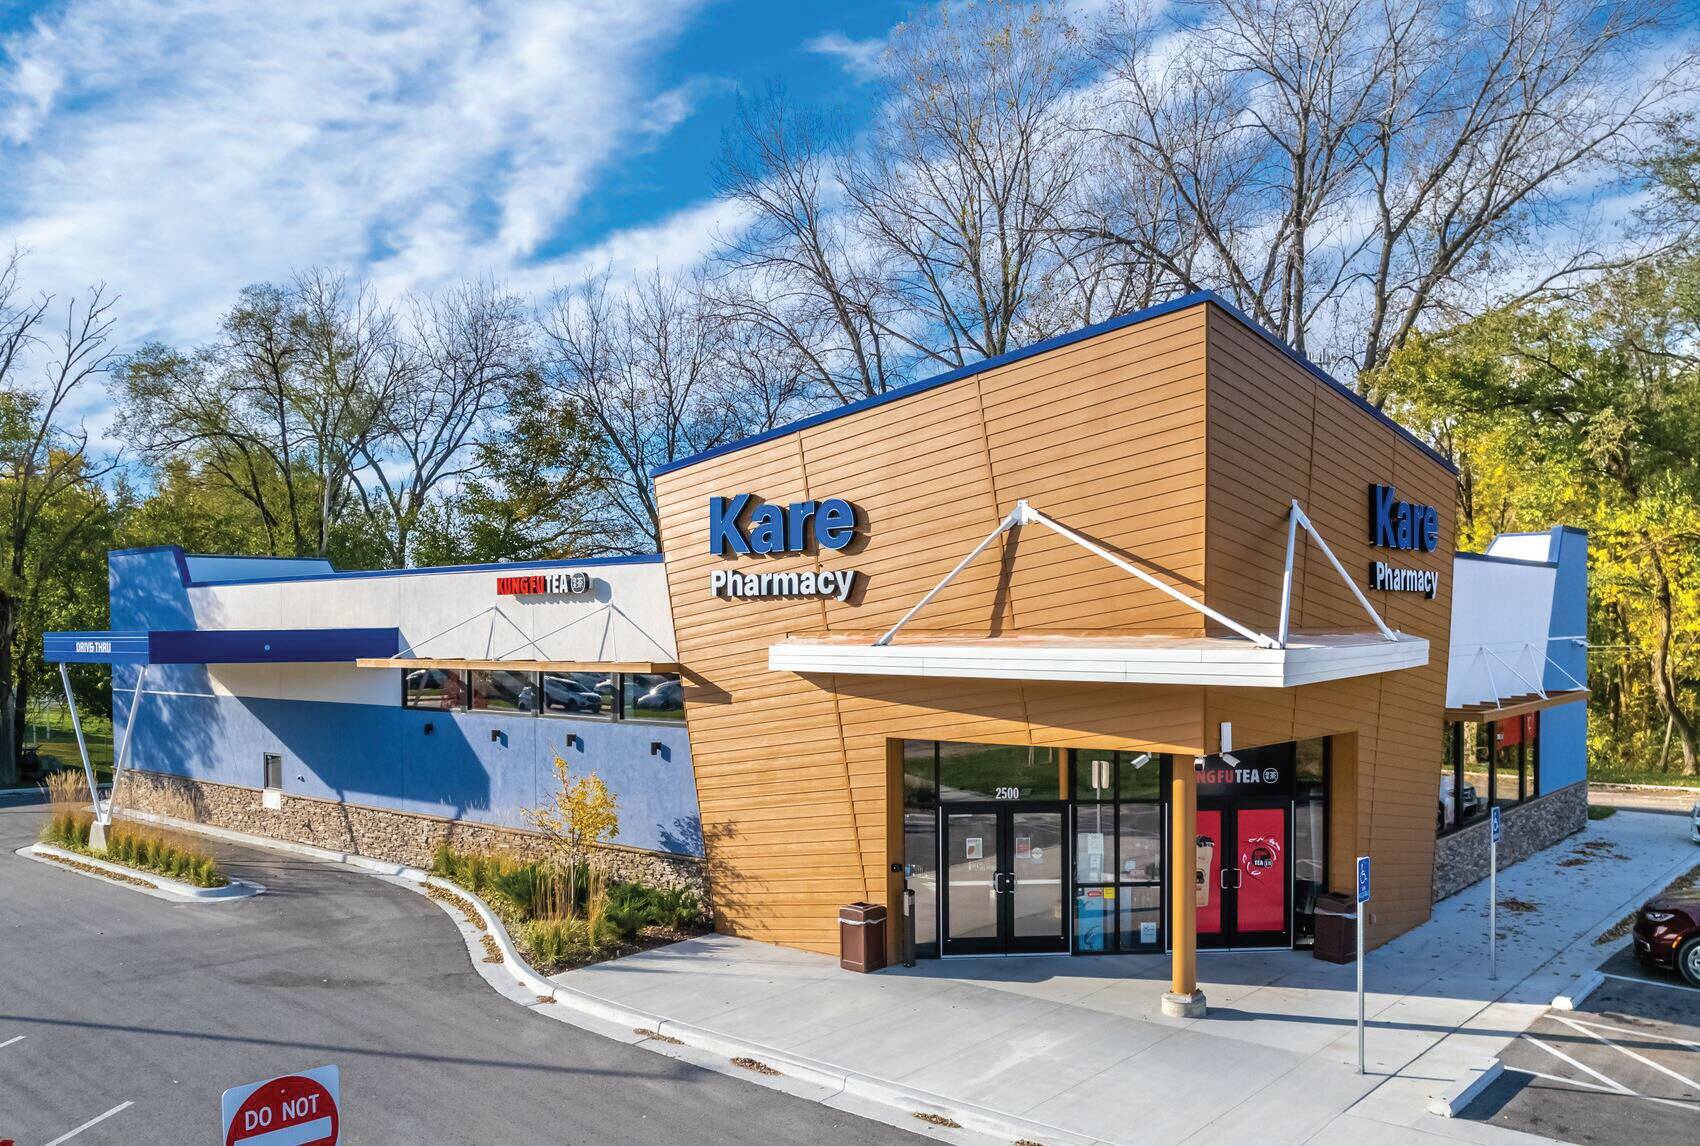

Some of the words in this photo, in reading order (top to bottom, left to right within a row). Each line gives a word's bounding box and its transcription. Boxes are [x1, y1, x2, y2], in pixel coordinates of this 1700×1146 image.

[709, 493, 855, 555] Kare
[1375, 484, 1438, 553] Kare
[545, 574, 569, 594] TEA
[710, 569, 856, 602] Pharmacy
[1376, 561, 1438, 600] Pharmacy
[95, 642, 111, 653] THRU
[1195, 770, 1216, 784] NG
[1235, 768, 1260, 784] TEA
[995, 786, 1020, 800] 2500
[244, 1106, 273, 1131] DO
[281, 1093, 320, 1122] NOT
